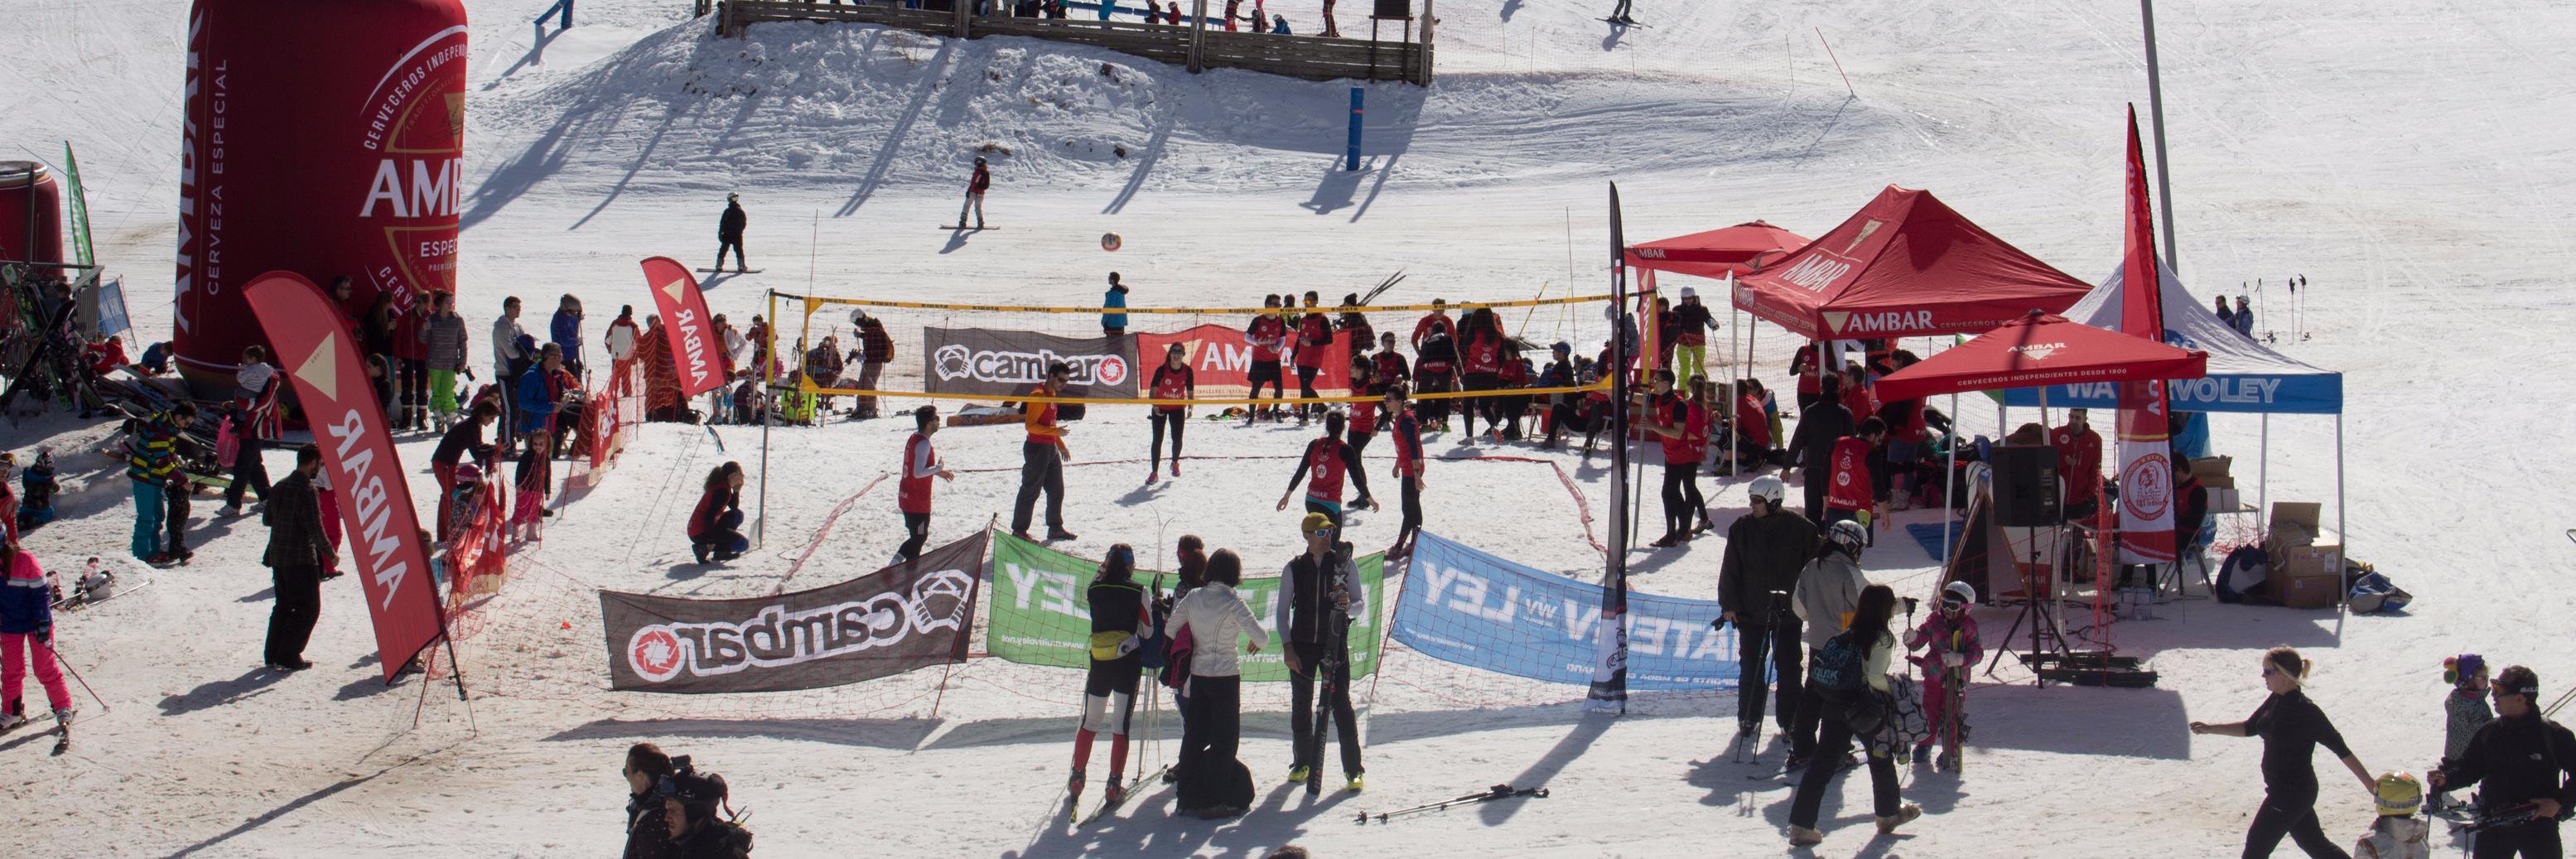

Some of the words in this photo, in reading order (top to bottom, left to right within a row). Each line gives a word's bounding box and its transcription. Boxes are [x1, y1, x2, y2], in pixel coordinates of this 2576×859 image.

[212, 60, 227, 175] ESPECIAL
[364, 66, 426, 150] CERVECEROS
[207, 185, 223, 296] CERVEZA
[1778, 253, 1850, 293] AMBAR
[1848, 310, 1936, 332] AMBAR
[1940, 320, 1995, 328] CERVECEROS
[2008, 342, 2067, 352] AMBAR
[1957, 376, 2009, 386] CERVECEROS
[2011, 371, 2078, 381] INDEPENDIENTES
